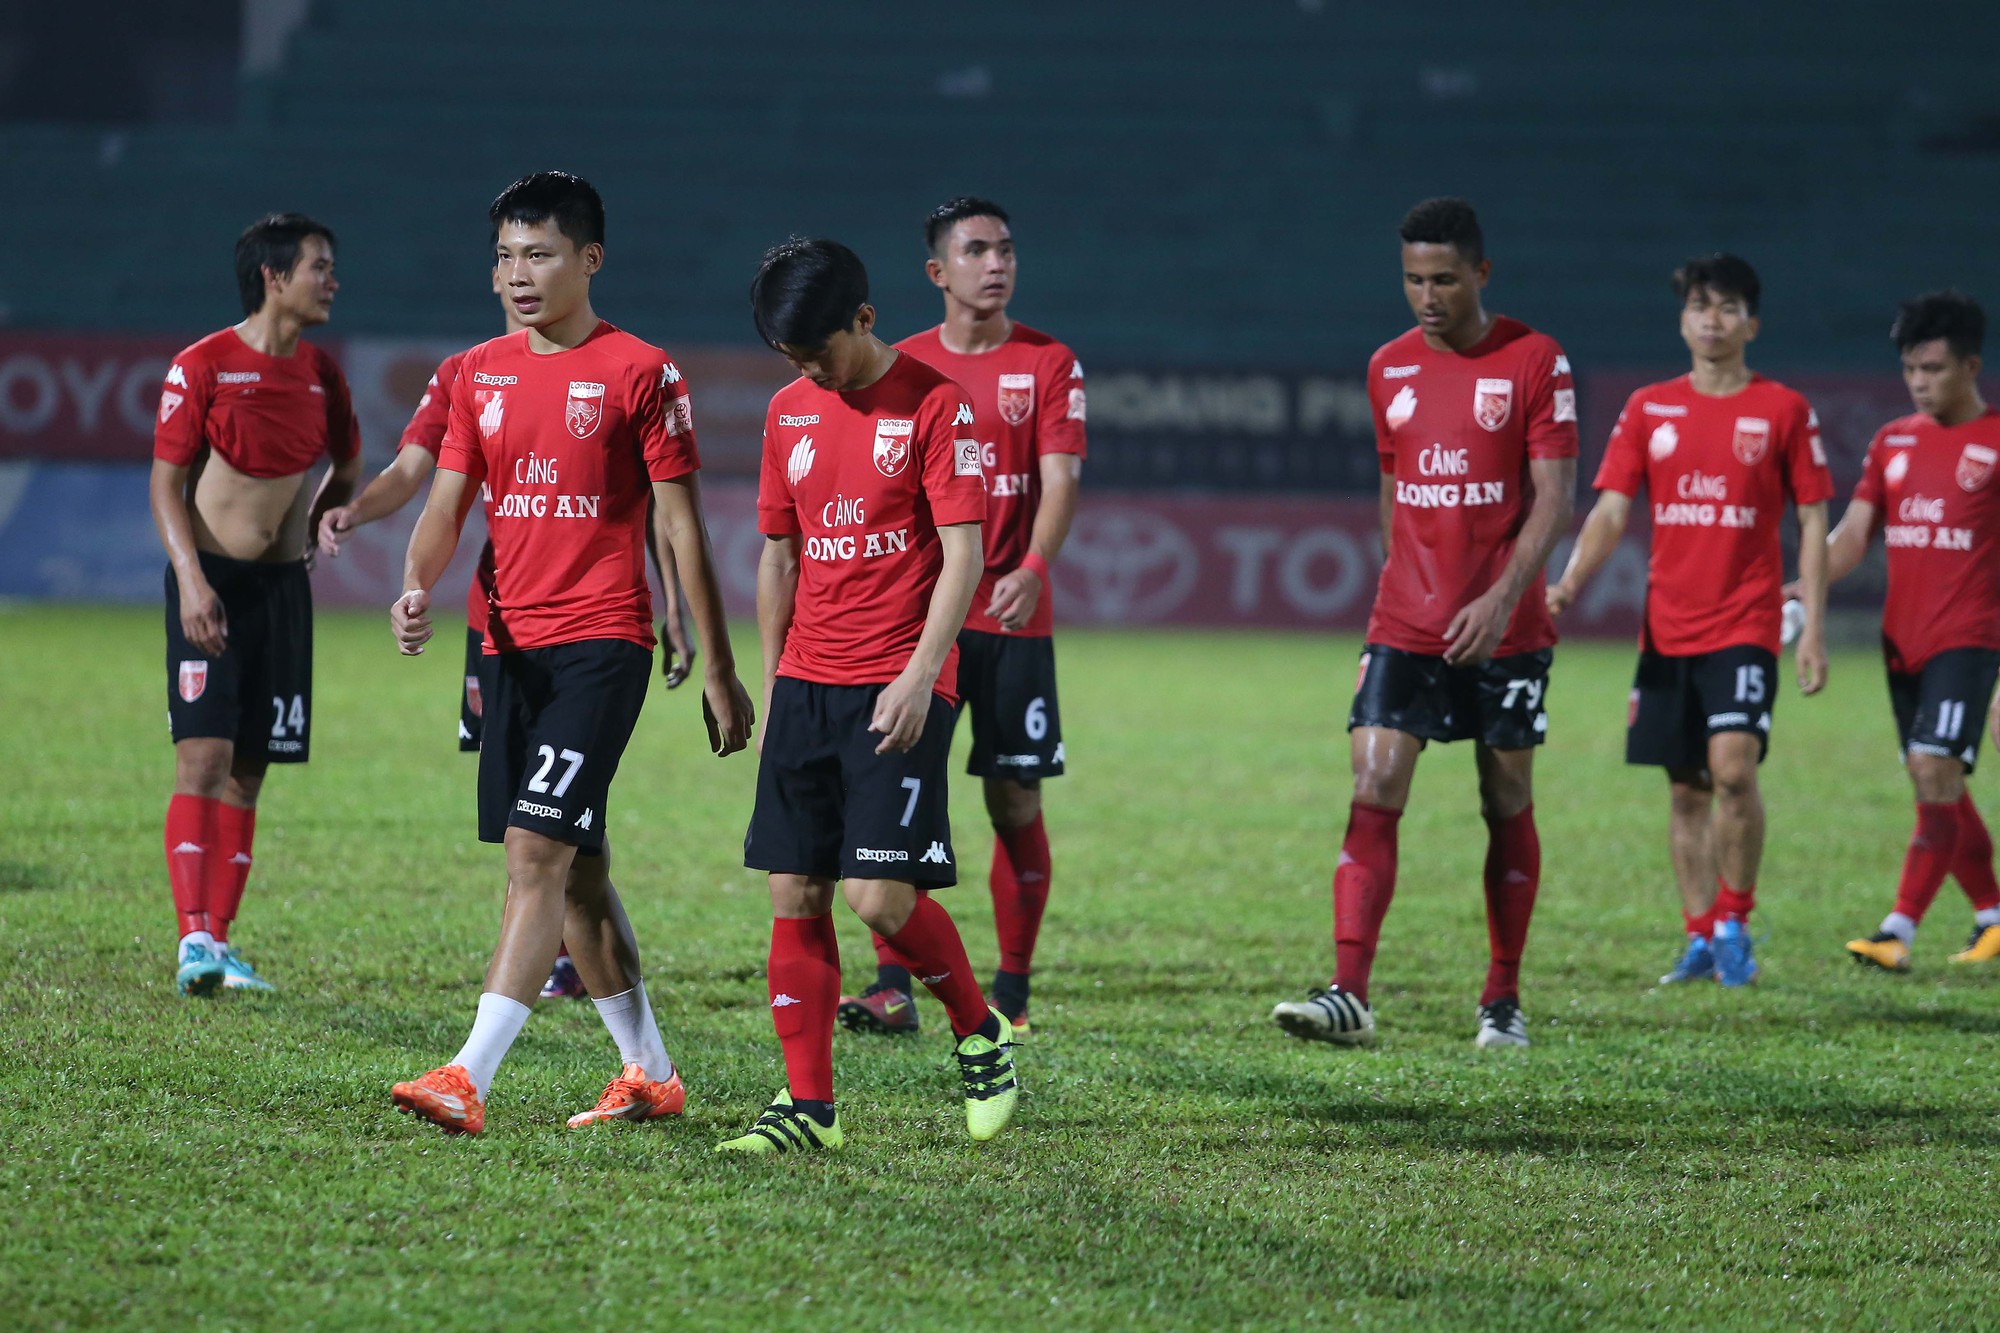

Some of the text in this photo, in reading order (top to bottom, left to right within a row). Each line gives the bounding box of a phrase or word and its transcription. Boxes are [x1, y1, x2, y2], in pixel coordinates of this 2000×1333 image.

[474, 371, 518, 387] Kappa
[570, 382, 591, 390] LONG
[779, 414, 820, 427] Kappa
[879, 419, 899, 427] LONG
[515, 452, 558, 484] CẢNG
[991, 473, 1029, 496] AN
[1396, 481, 1505, 508] LONG AN
[554, 495, 600, 517] AN
[822, 494, 865, 527] CẢNG
[1654, 502, 1757, 529] LONG AN
[804, 529, 908, 560] ONG AN
[1735, 665, 1765, 702] 15
[271, 694, 305, 738] 24
[1024, 697, 1048, 740] 6
[1934, 699, 1965, 740] 11
[528, 744, 585, 798] 27
[517, 800, 562, 819] Kappa
[900, 777, 921, 828] 7
[856, 848, 909, 862] Kappa
